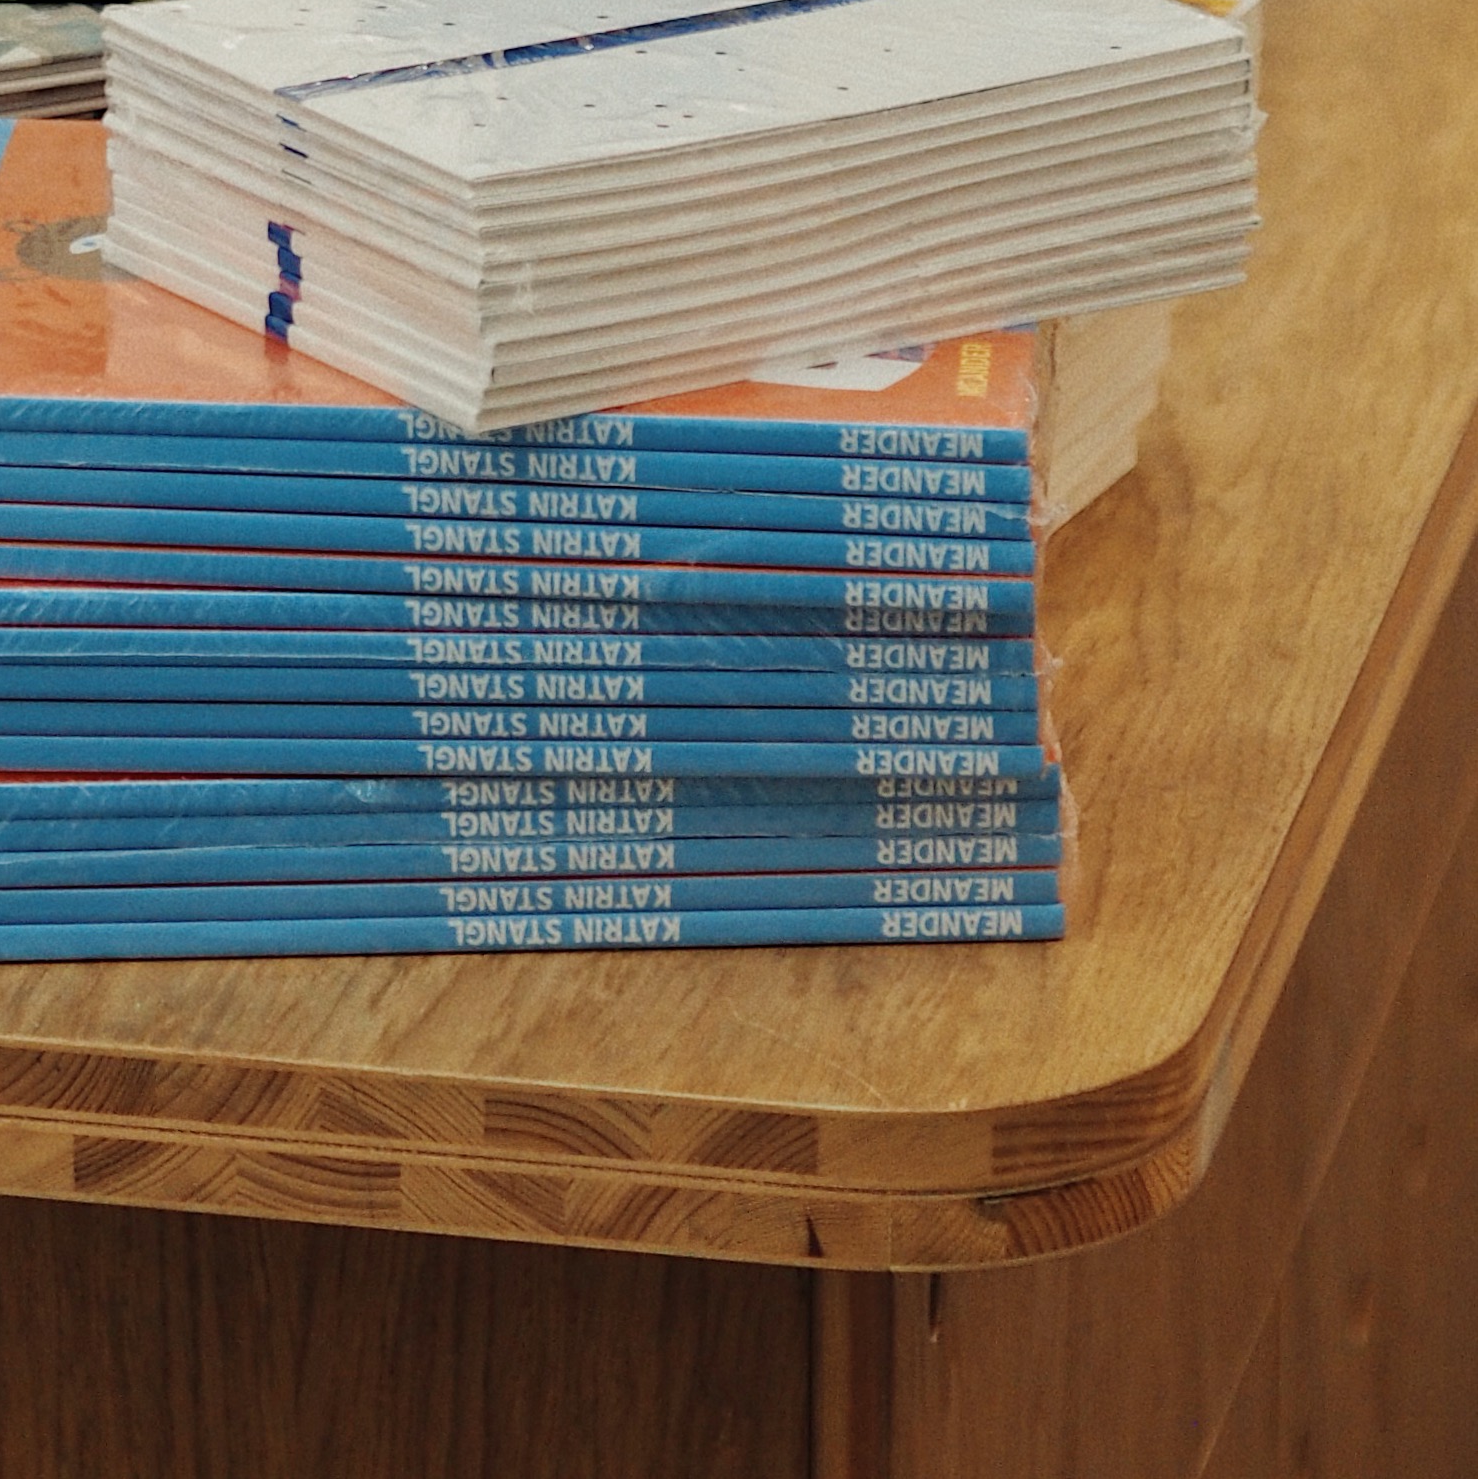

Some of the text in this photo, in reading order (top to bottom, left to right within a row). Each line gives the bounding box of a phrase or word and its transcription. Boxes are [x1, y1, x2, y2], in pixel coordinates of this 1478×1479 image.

[526, 419, 635, 446] KATRIN
[840, 428, 983, 458] MEANDER
[401, 447, 637, 482] KATRIN STANGL
[842, 465, 985, 496] MEANDER
[402, 485, 638, 521] KATRIN STANGL
[842, 502, 986, 534] MEANDER
[405, 523, 642, 559] KATRIN STANGL
[846, 541, 990, 570] MEANDER
[404, 566, 640, 599] KATRIN STANGL
[844, 581, 988, 610] MEANDER
[404, 600, 640, 630] KATRIN STANGL
[845, 608, 987, 632] MEANDER
[407, 637, 642, 666] KATRIN STANGL
[846, 643, 990, 668] MEANDER
[410, 673, 644, 700] KATRIN STANGL
[849, 679, 992, 705] MEANDER
[412, 710, 647, 737] KATRIN STANGL
[852, 715, 994, 740] MEANDER
[417, 744, 653, 773] KATRIN STANGL
[856, 749, 999, 776] MEANDER
[442, 779, 674, 806] KATRIN STANGL
[876, 777, 1018, 798] MEANDER
[440, 808, 673, 837] KATRIN STANGL
[876, 802, 1017, 829] MEANDER
[442, 843, 675, 872] KATRIN STANGL
[877, 836, 1018, 864] MEANDER
[439, 884, 672, 912] KATRIN STANGL
[874, 877, 1014, 902] MEANDER
[448, 916, 681, 945] KATRIN STANGL
[882, 912, 1023, 938] MEANDER
